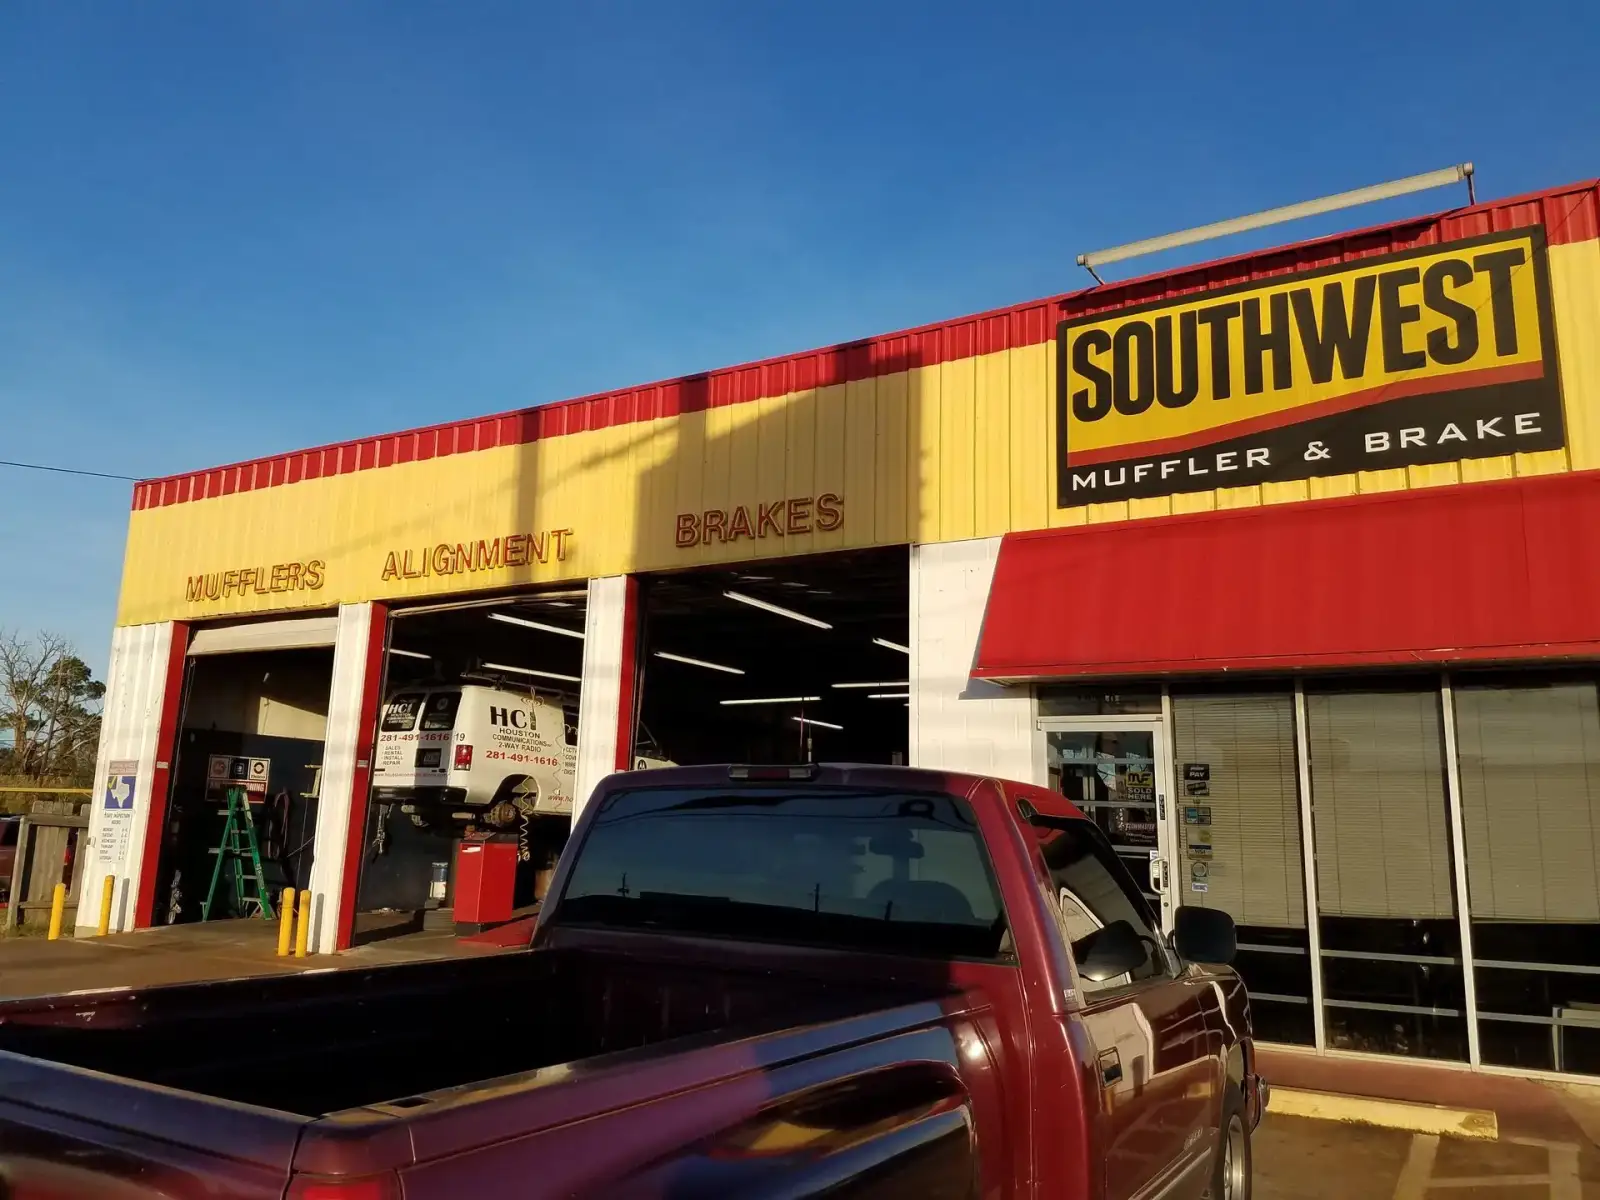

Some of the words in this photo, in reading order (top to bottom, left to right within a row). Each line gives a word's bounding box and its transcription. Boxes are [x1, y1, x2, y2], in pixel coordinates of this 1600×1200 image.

[1072, 247, 1526, 422] SOUTHWEST
[1073, 447, 1271, 491] MUFFLER
[1303, 440, 1331, 461] &
[1364, 412, 1542, 454] BRAKE
[675, 493, 845, 547] BRAKES
[381, 527, 573, 581] ALIGNMENT
[185, 559, 326, 602] MUFFLERS
[380, 732, 450, 742] 281-491-1616
[492, 733, 548, 748] COMMUNICATIONS
[498, 741, 521, 750] 2-WAY
[521, 743, 542, 753] RADIO
[499, 727, 541, 739] HOUSTON
[485, 750, 558, 767] 281-491-1616
